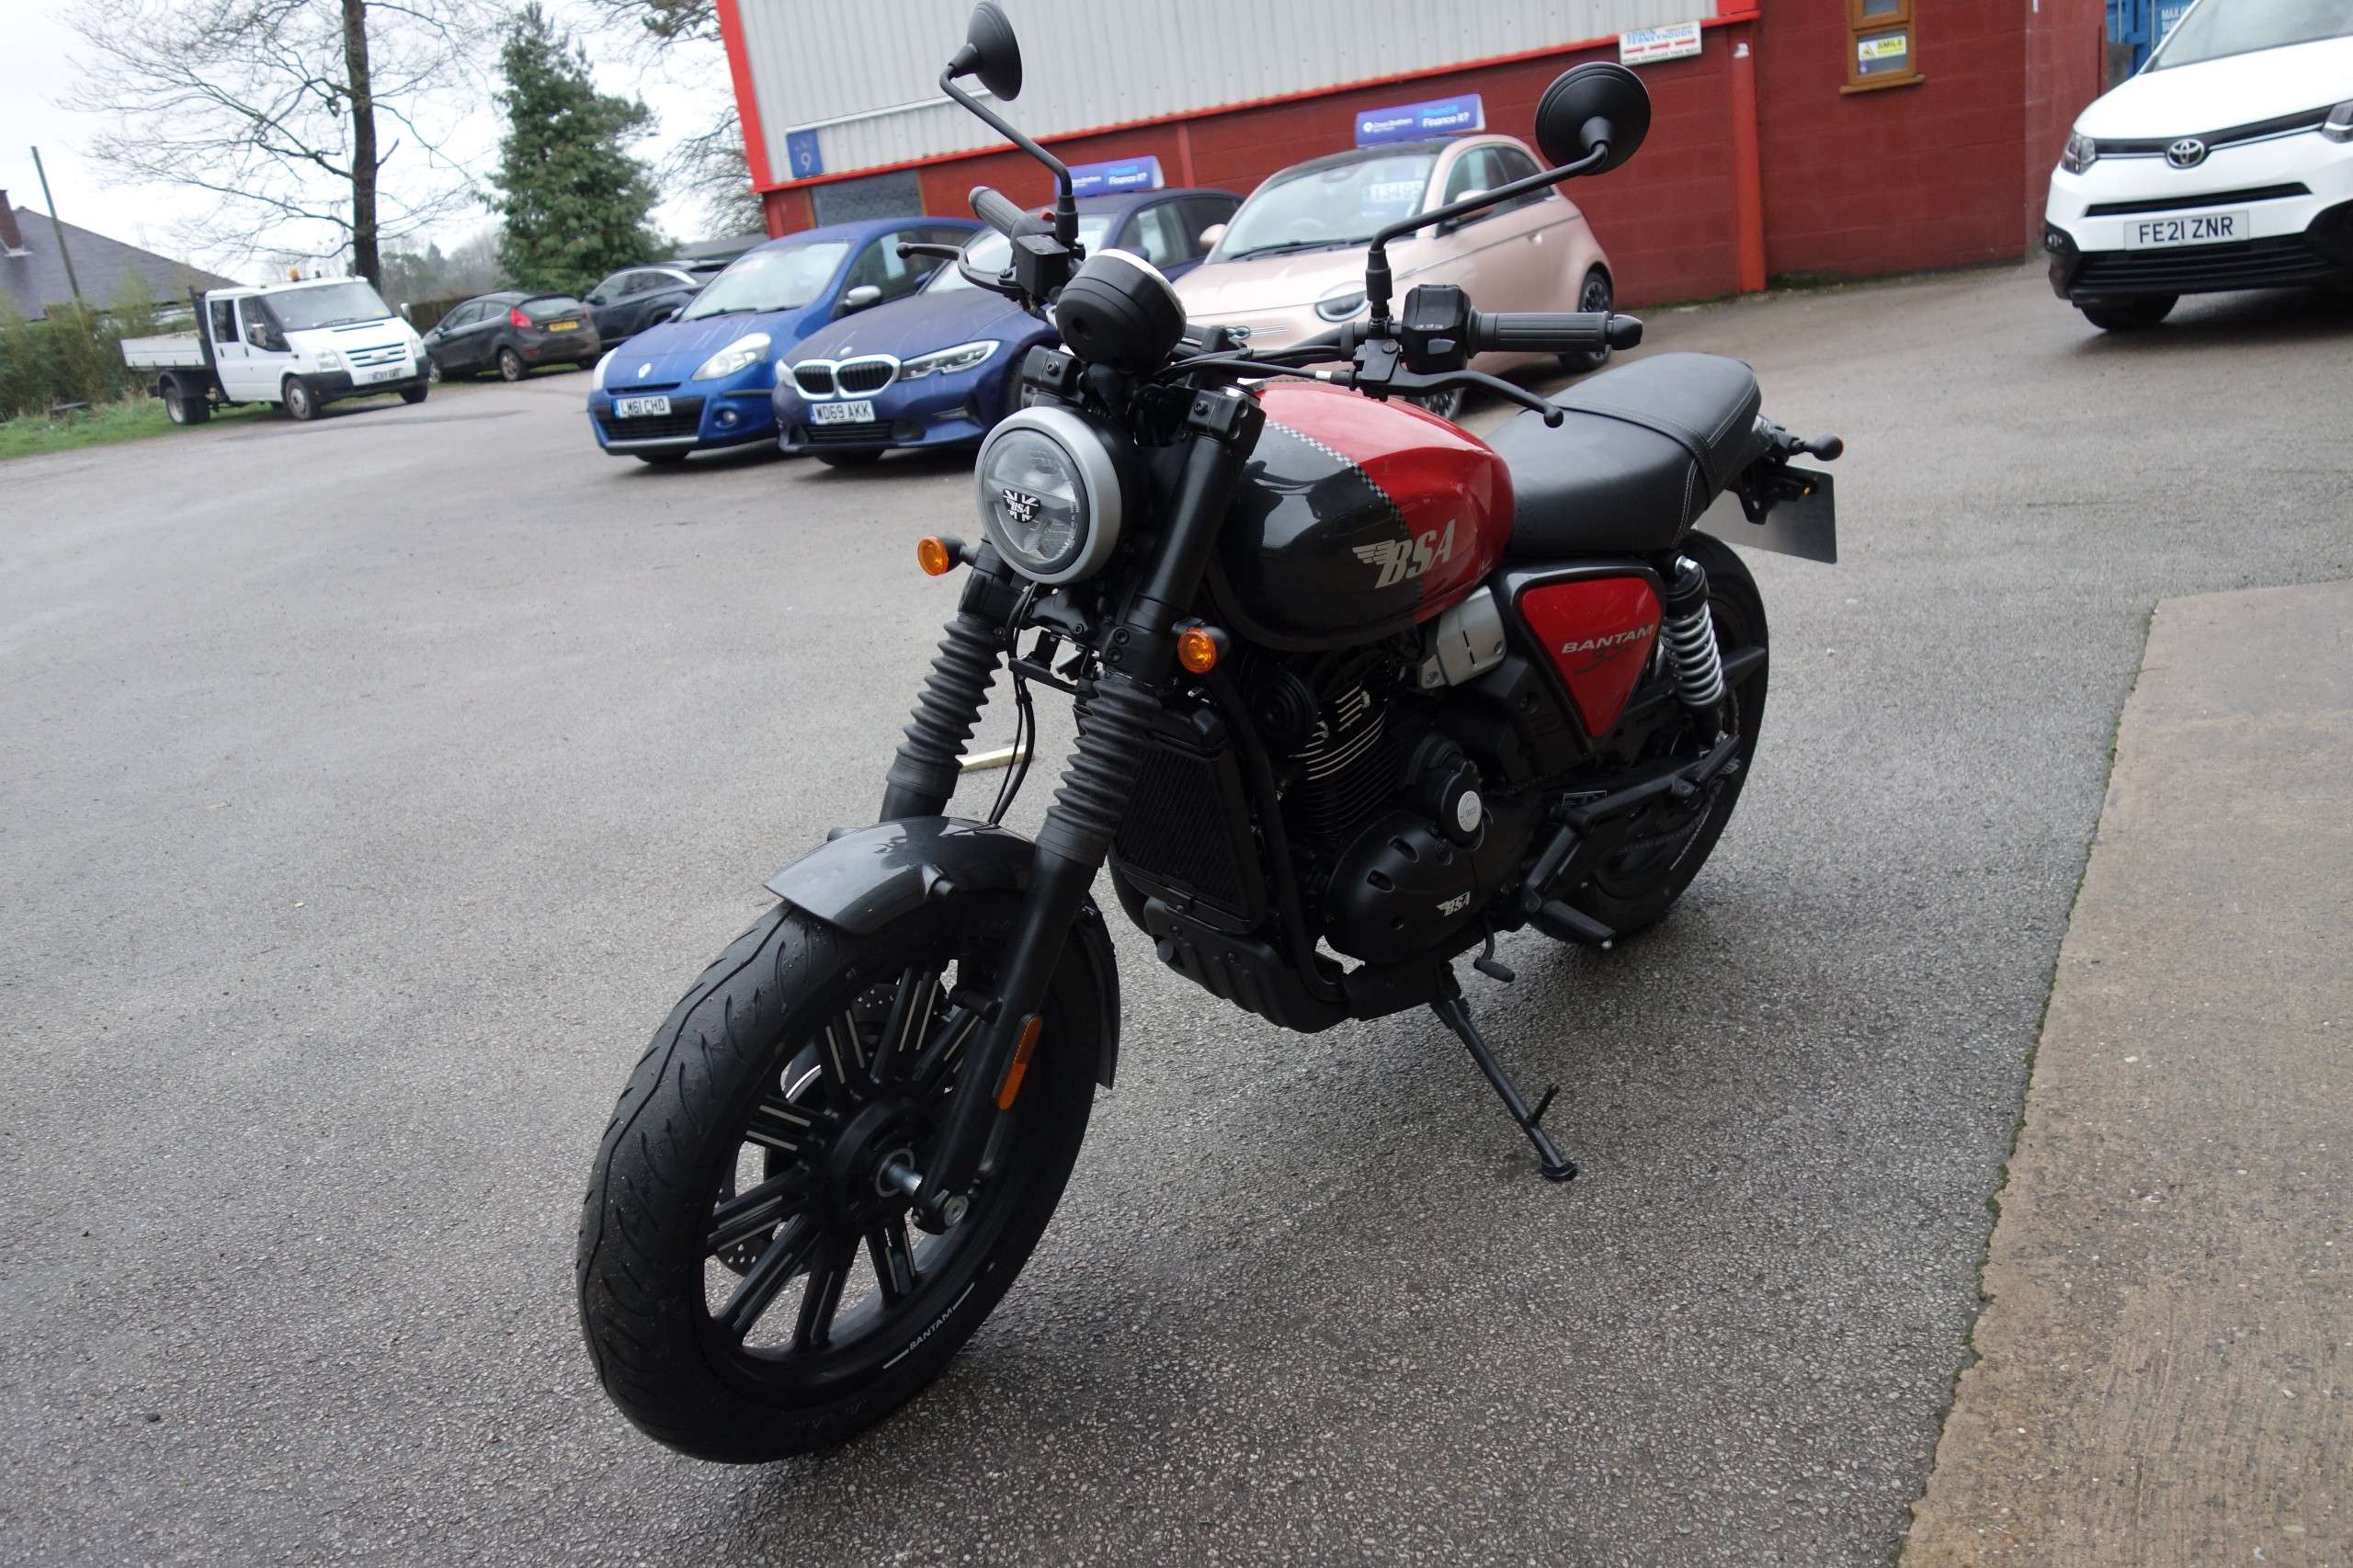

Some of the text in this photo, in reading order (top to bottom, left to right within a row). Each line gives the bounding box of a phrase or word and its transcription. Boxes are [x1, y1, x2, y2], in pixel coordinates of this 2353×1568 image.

[1422, 115, 1457, 128] Finance
[801, 153, 812, 171] 9
[2139, 216, 2234, 244] FE21 ZNR
[847, 403, 871, 417] AKK
[1373, 518, 1456, 589] BSA
[1562, 624, 1654, 654] BANTAM
[1440, 892, 1471, 916] BSA
[909, 1307, 953, 1351] BANTAM
